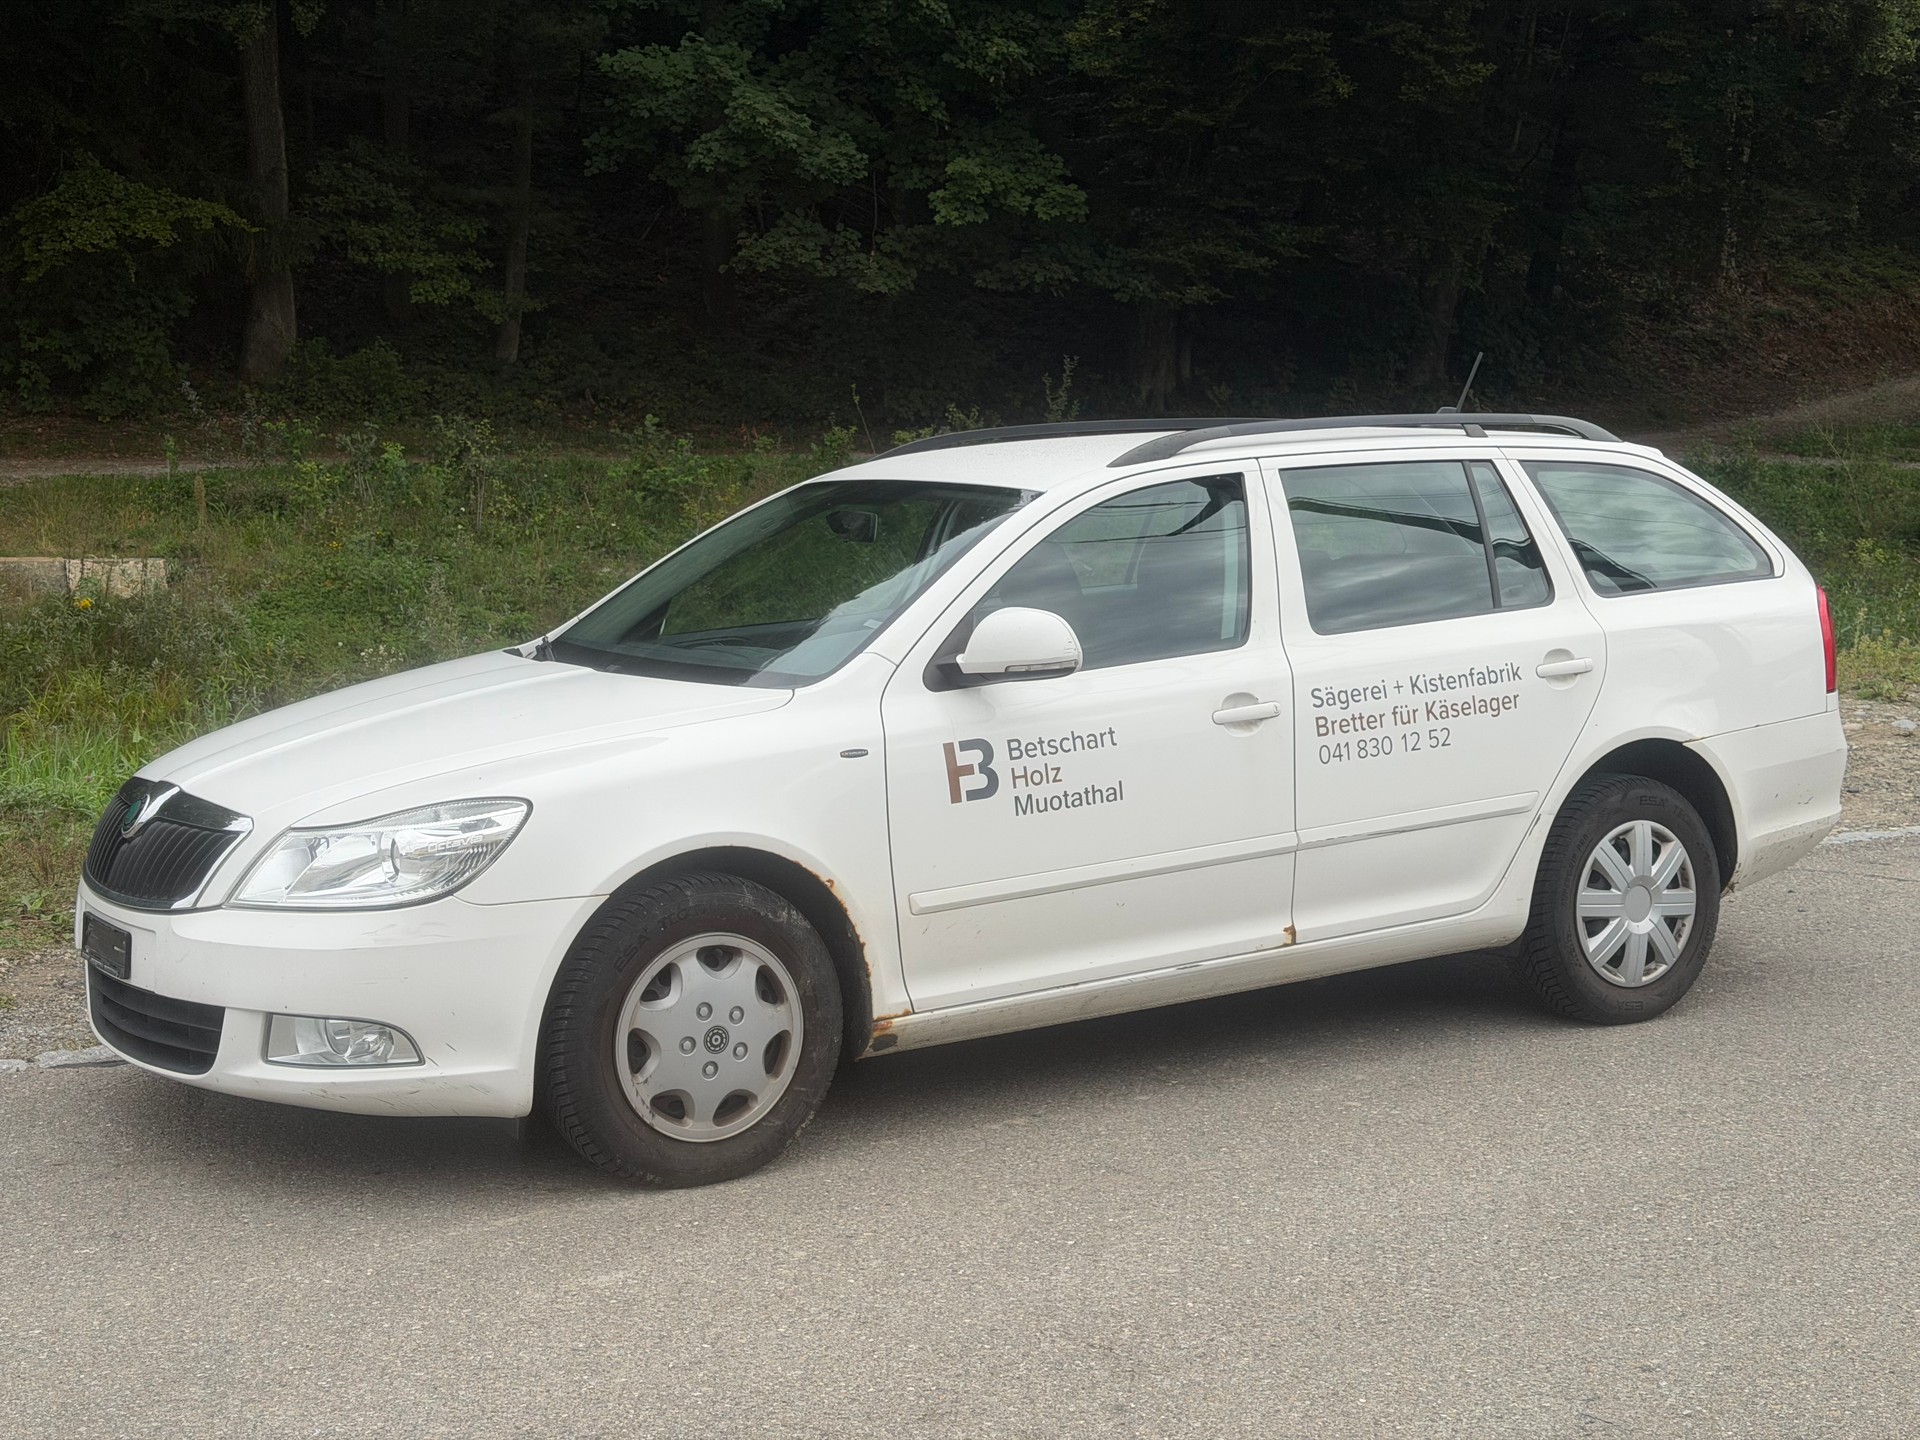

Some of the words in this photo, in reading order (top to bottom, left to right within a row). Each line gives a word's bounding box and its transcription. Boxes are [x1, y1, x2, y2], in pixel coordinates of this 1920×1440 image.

[1310, 679, 1388, 710] Sägerei
[1393, 680, 1404, 694] +
[1409, 662, 1523, 695] Kistenfabrik
[1315, 711, 1386, 737] Bretter
[1391, 705, 1419, 726] für
[1425, 693, 1520, 722] Käselager
[1006, 727, 1118, 761] Betschart
[1318, 741, 1351, 765] 041
[1356, 735, 1393, 760] 830
[1400, 731, 1421, 752] 12
[1428, 727, 1452, 749] 52
[1011, 763, 1063, 789] Holz
[1014, 780, 1124, 816] Muotathal
